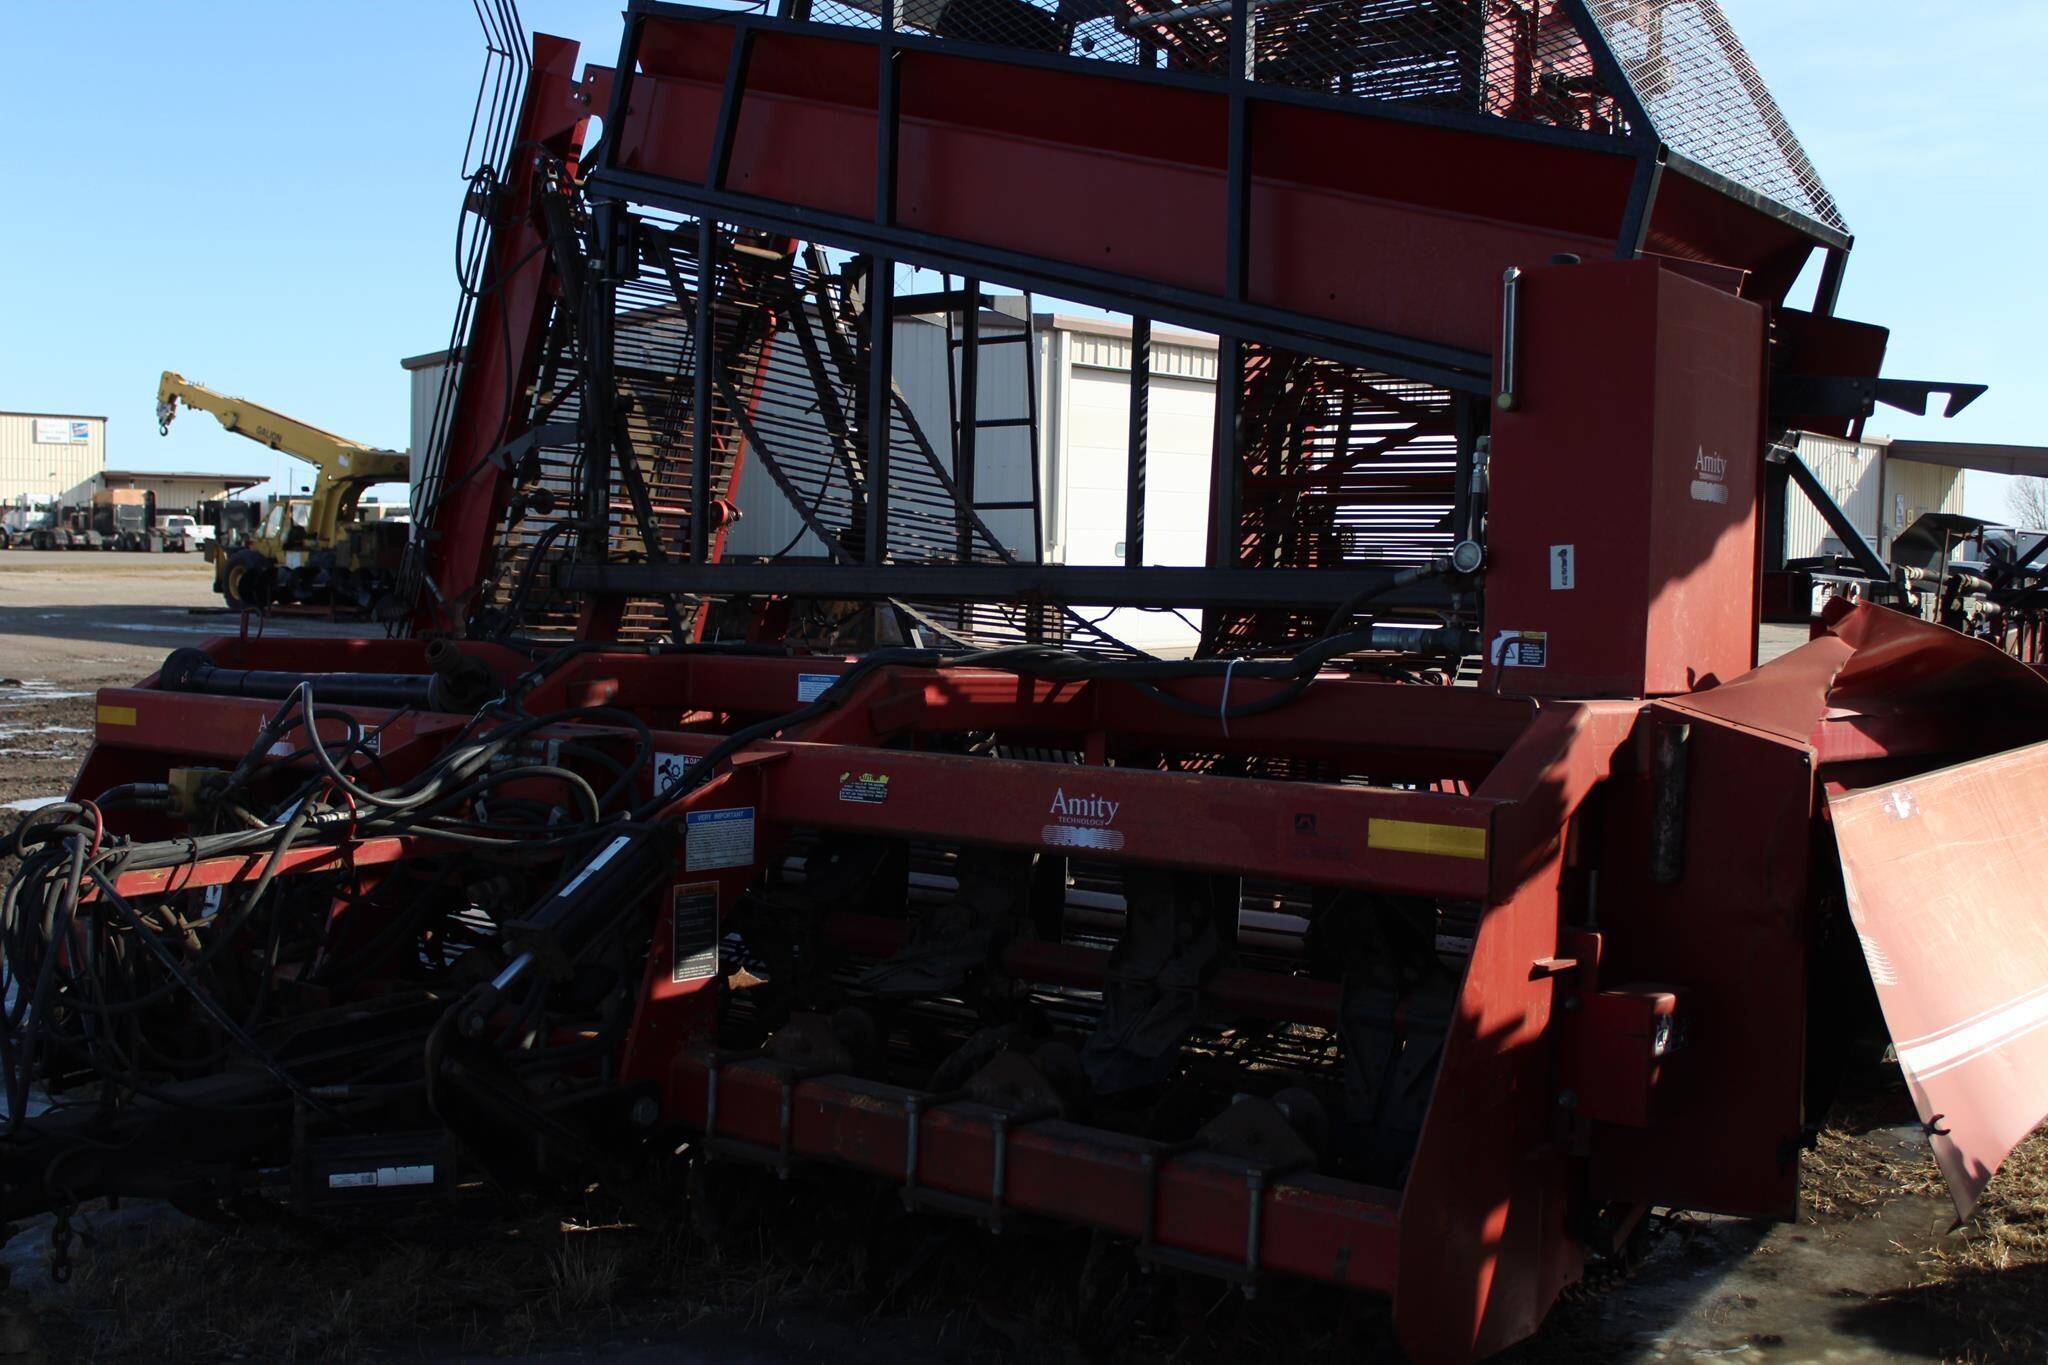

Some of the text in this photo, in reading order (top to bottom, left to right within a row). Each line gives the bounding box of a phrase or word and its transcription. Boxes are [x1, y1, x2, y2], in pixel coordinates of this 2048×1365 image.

[1694, 444, 1728, 481] Amity
[1049, 786, 1120, 825] Amity
[1058, 816, 1105, 826] TECHNOLOGY
